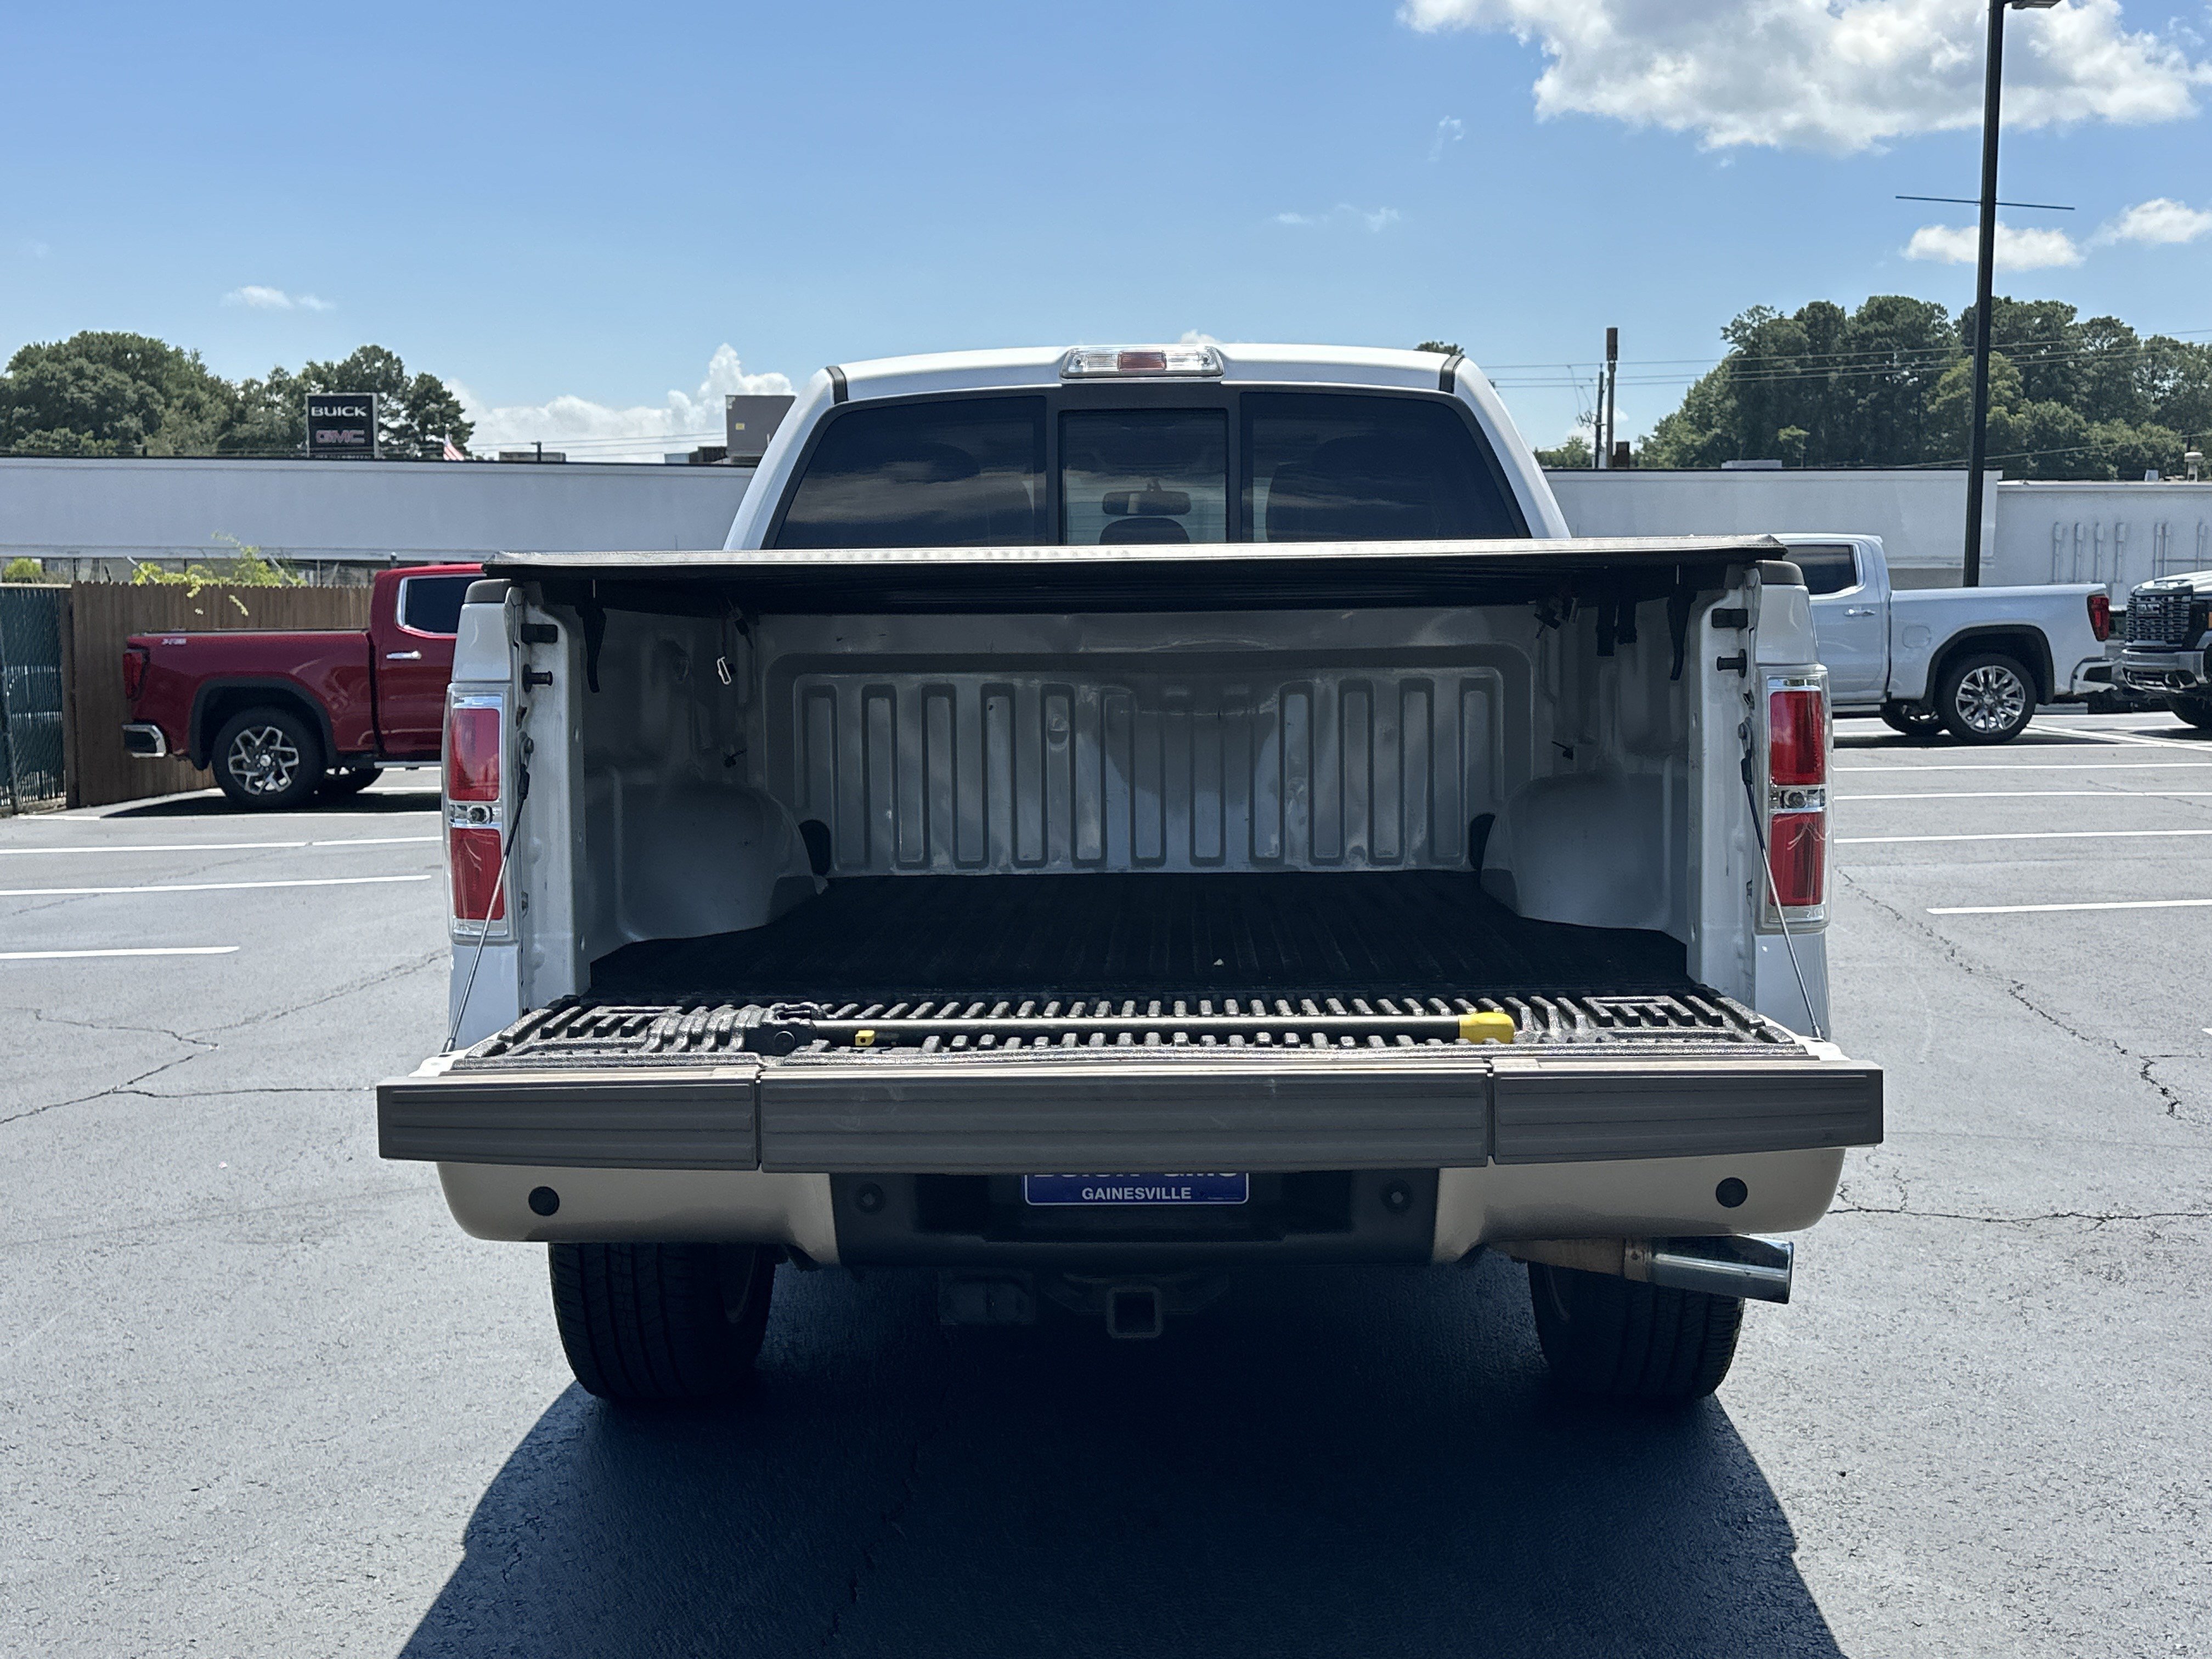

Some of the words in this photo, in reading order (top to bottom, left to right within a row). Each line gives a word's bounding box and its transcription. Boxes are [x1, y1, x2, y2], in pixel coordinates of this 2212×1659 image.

[311, 406, 366, 416] BUICK
[315, 430, 365, 443] GMC
[1081, 1187, 1192, 1200] GAINESVILLE
